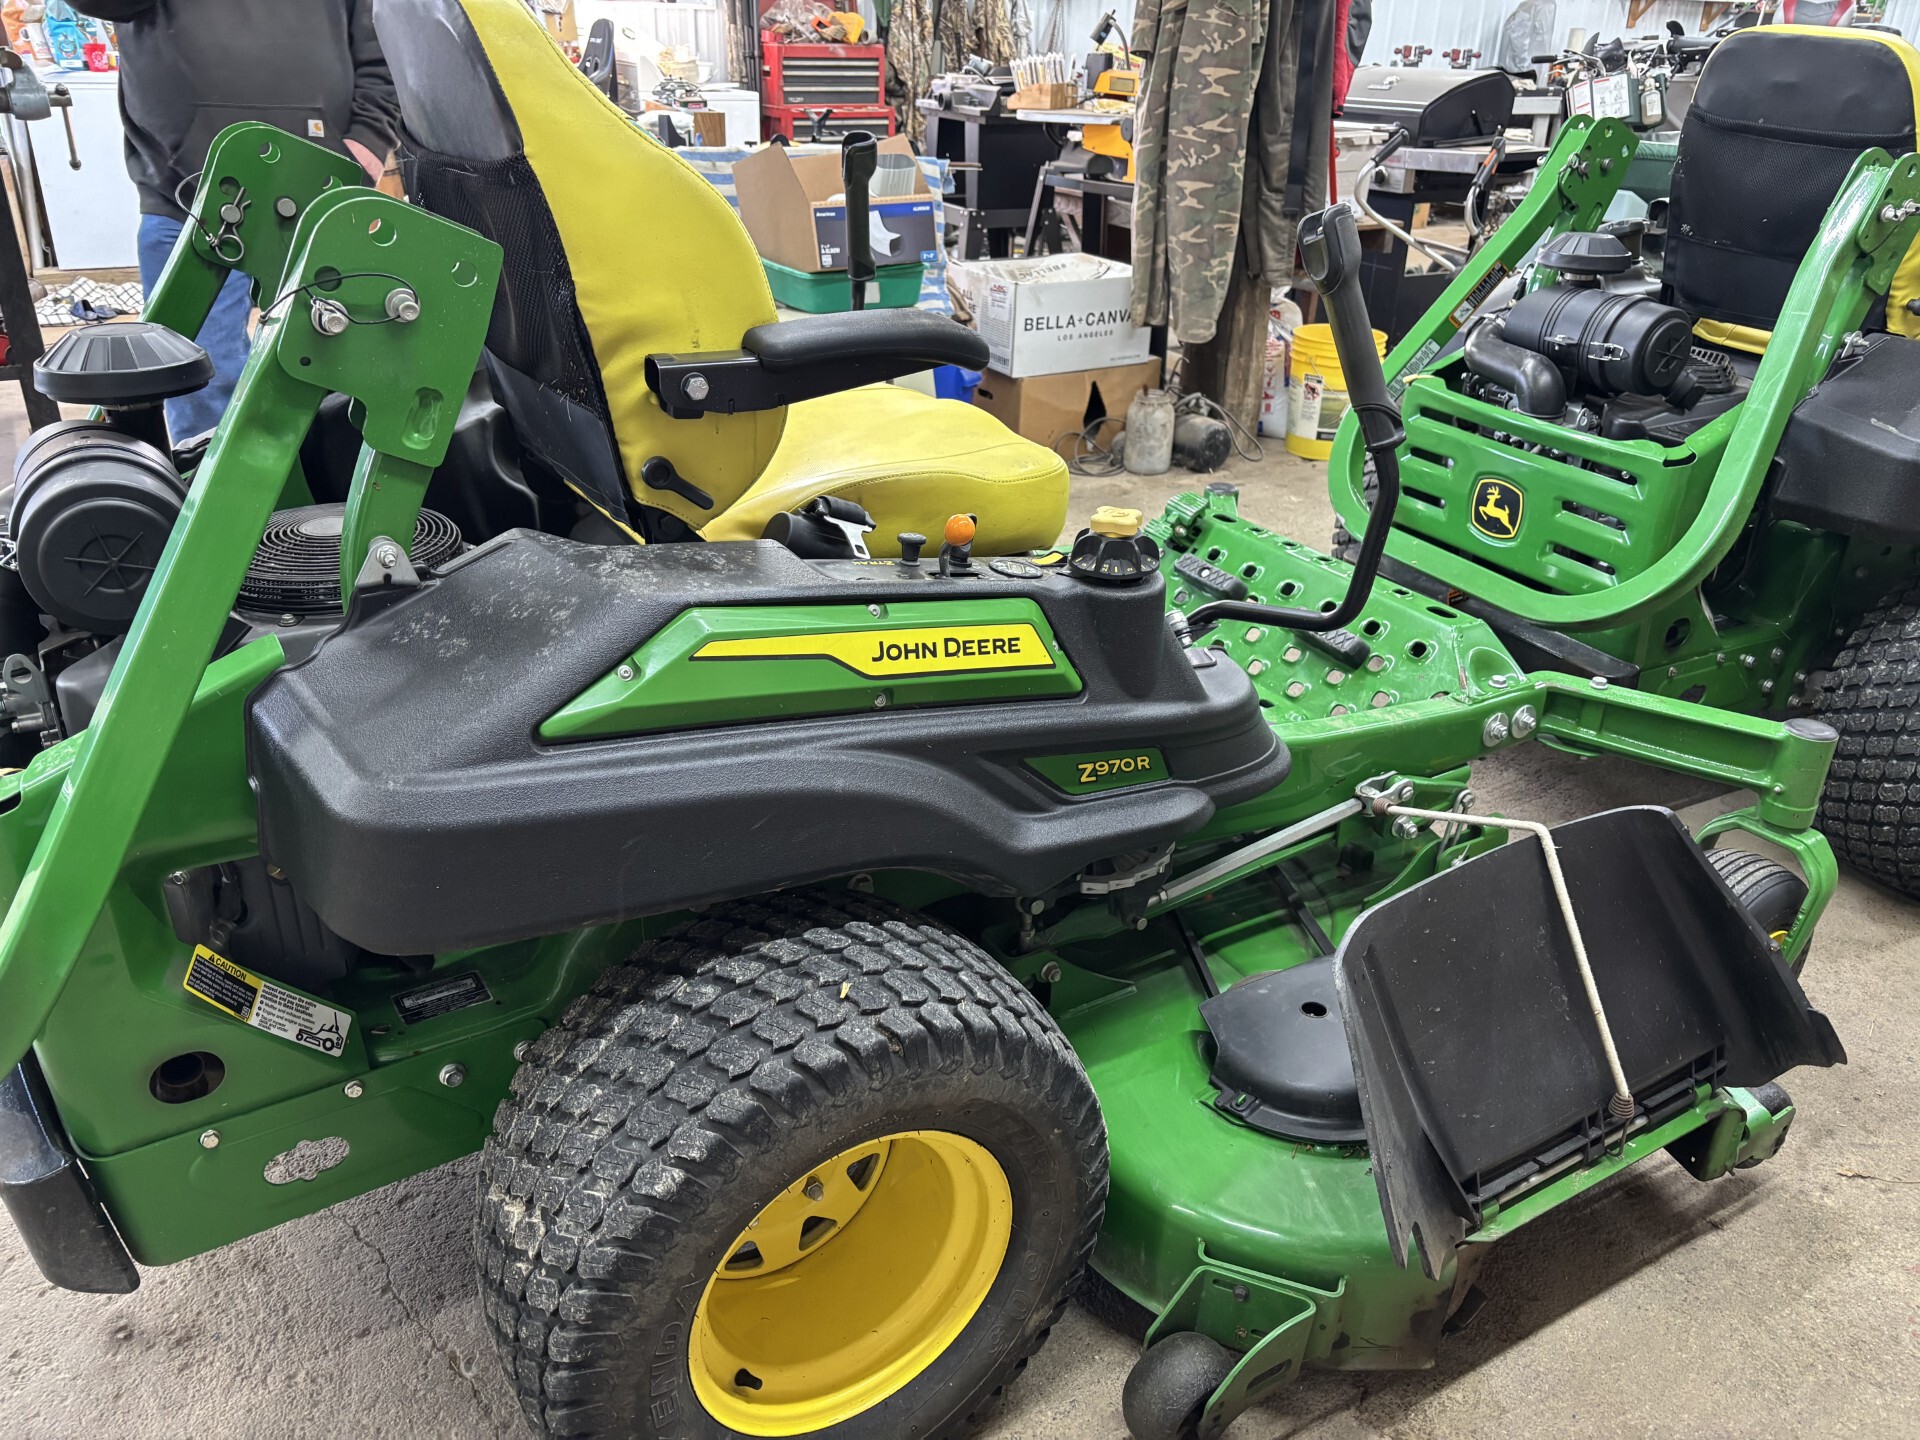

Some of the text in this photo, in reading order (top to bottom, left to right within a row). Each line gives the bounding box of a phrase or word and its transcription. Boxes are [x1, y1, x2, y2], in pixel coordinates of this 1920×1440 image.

[871, 637, 1021, 662] JOHN DEERE
[1077, 755, 1151, 783] Z970R
[215, 957, 247, 981] CAUTION
